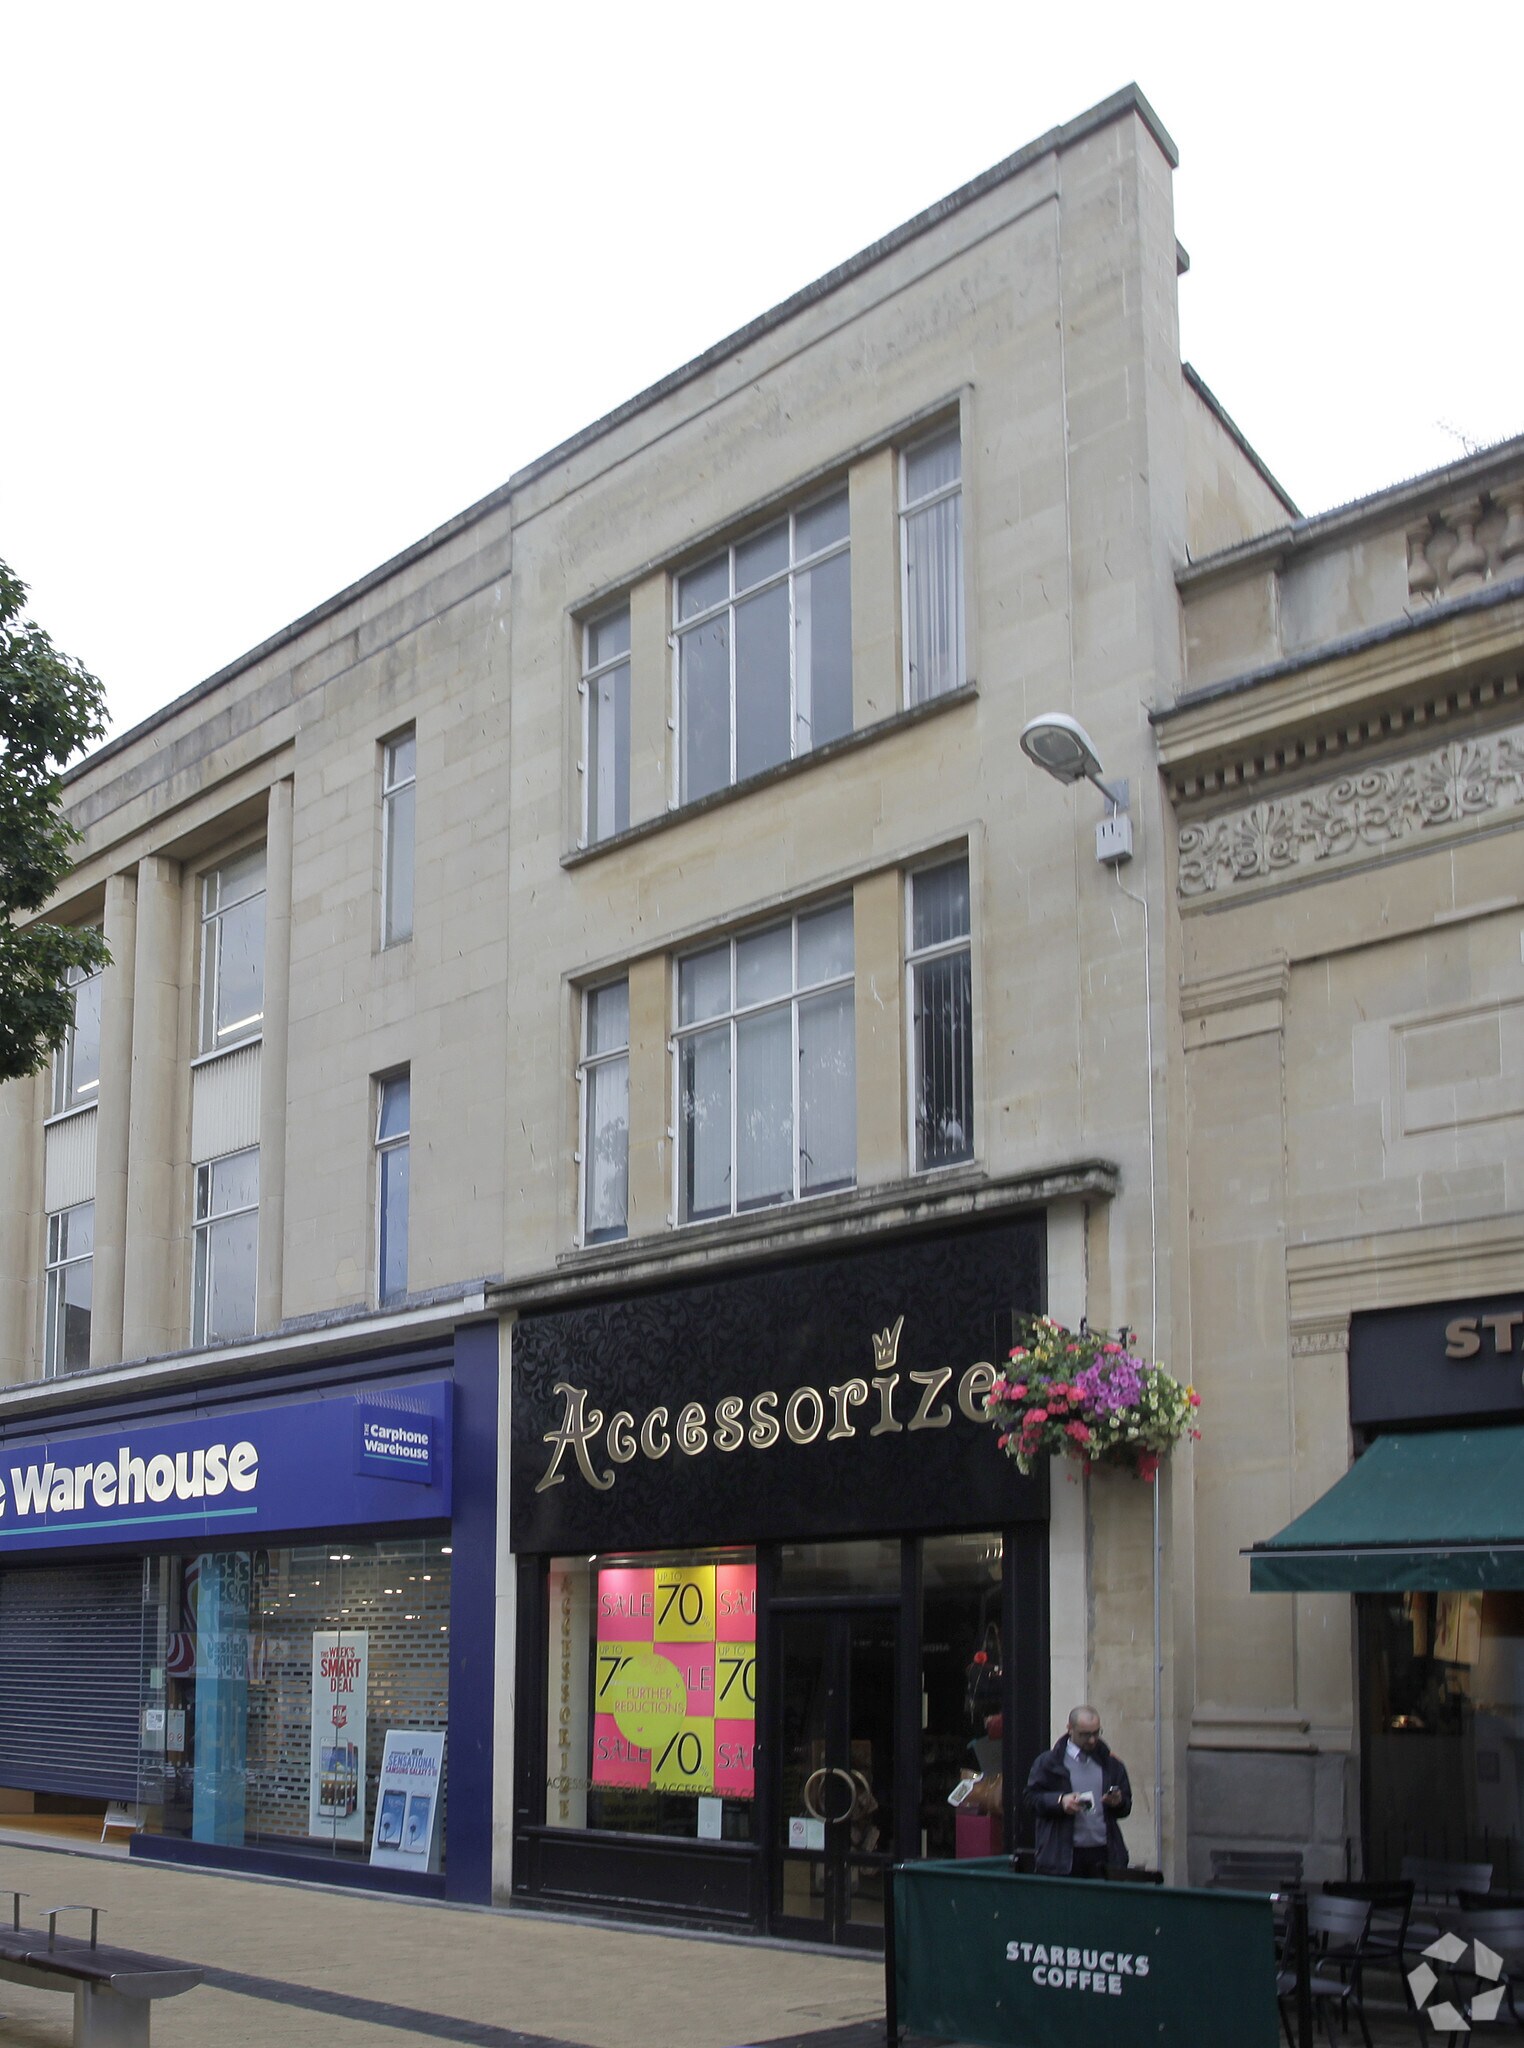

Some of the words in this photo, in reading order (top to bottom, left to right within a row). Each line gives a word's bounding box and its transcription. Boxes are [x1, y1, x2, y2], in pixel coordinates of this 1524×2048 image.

[1445, 1311, 1524, 1358] ST
[536, 1315, 997, 1492] Accessorize
[370, 1424, 429, 1445] Carphone
[364, 1439, 429, 1460] Warehouse
[10, 1441, 259, 1516] Warehouse
[601, 1593, 653, 1617] SALE
[720, 1590, 756, 1616] SAL
[320, 1659, 361, 1678] SMART
[599, 1656, 633, 1697] 7
[678, 1666, 712, 1691] LE
[330, 1678, 354, 1693] DEAL
[627, 1687, 672, 1700] FURTHER
[615, 1701, 684, 1715] REDUCTIONS
[388, 1755, 436, 1769] SENSATIONAL
[1006, 1940, 1150, 1977] STARBUCKS
[1032, 1965, 1122, 1996] COFFEE
